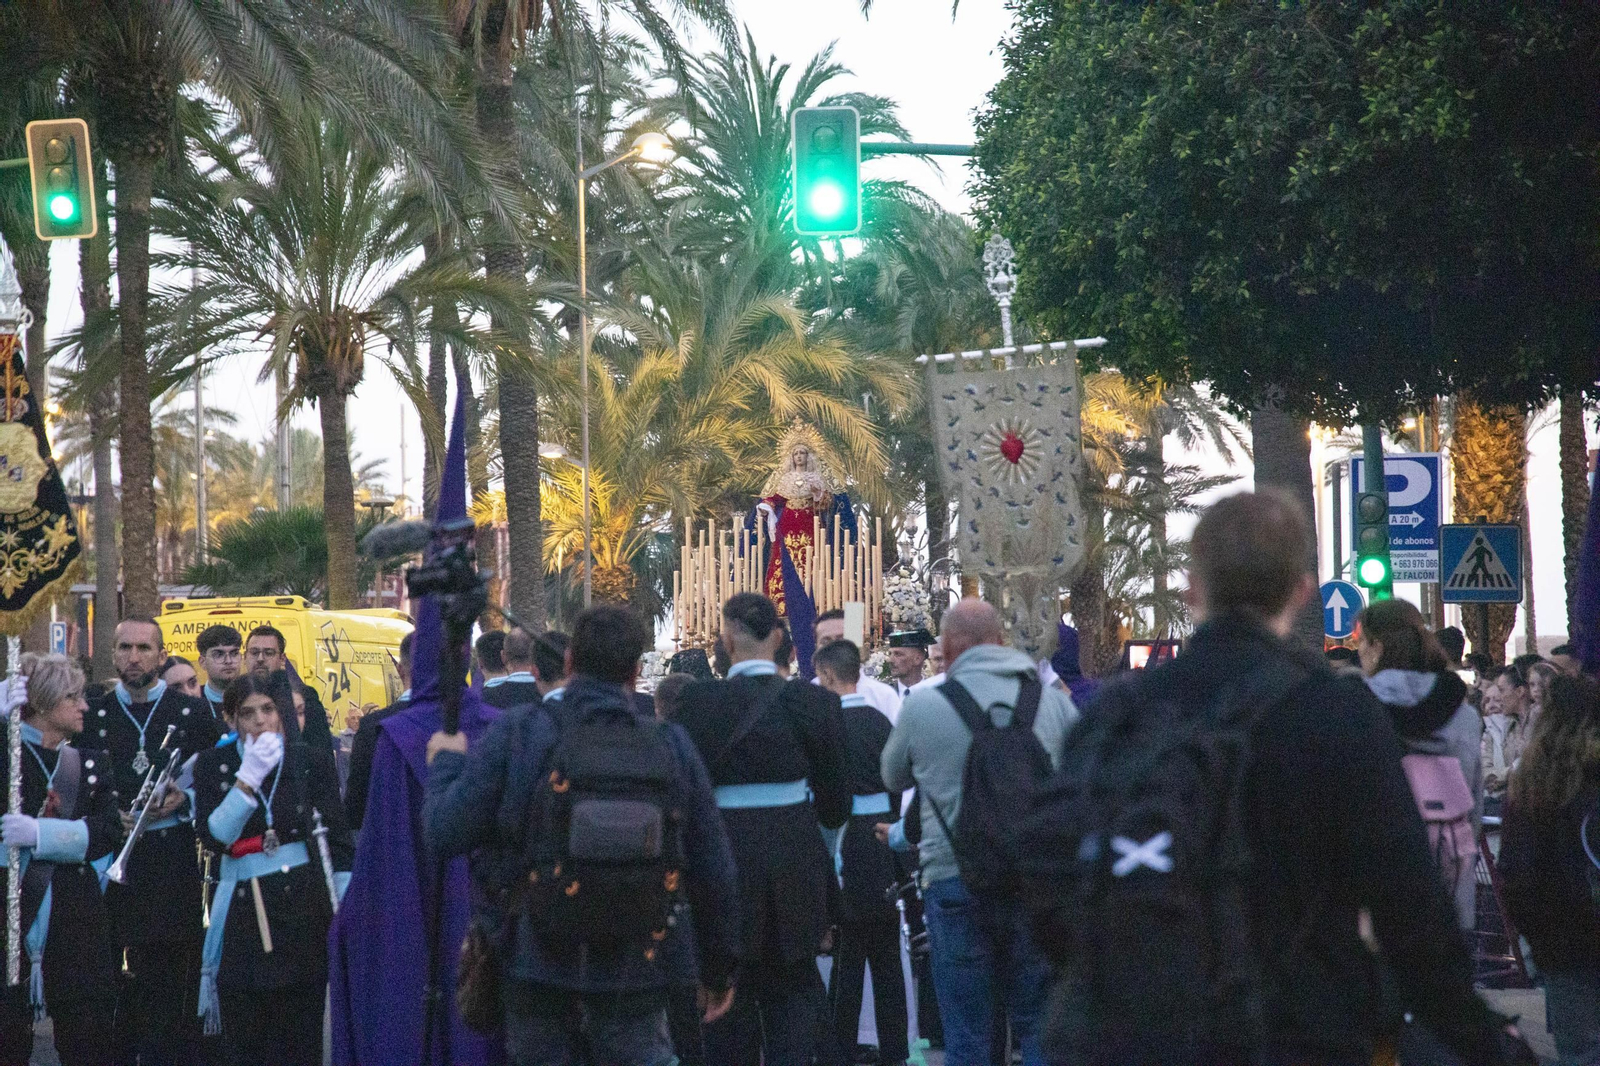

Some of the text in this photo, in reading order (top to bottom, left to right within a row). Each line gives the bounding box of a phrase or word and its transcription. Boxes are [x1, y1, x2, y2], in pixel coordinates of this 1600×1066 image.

[1358, 460, 1432, 507] P
[1391, 515, 1398, 524] A
[1399, 515, 1410, 524] 20
[1392, 537, 1403, 545] de
[1404, 536, 1435, 545] abonos
[1398, 559, 1411, 568] 663
[1412, 559, 1425, 568] 976
[1403, 569, 1435, 580] FALCÓN
[53, 625, 64, 650] P
[354, 651, 383, 664] SOPORTE
[327, 661, 351, 703] 24
